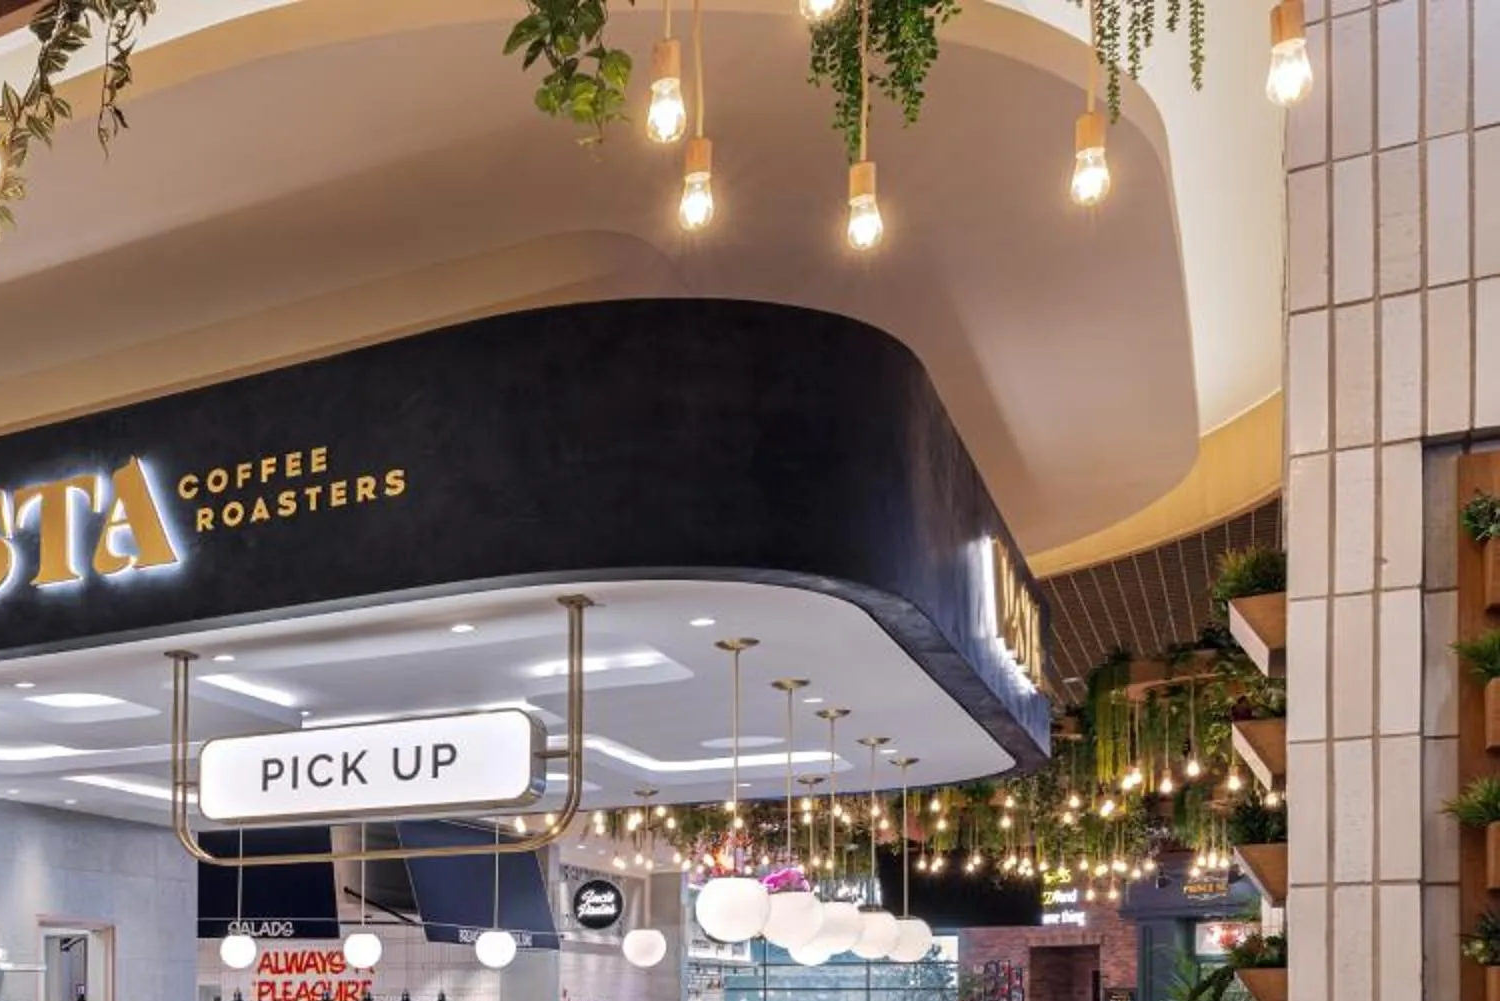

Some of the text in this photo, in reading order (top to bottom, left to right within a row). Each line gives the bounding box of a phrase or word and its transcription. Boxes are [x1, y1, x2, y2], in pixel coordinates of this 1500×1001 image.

[177, 446, 328, 500] COFFEE
[196, 469, 406, 532] ROASTERS
[261, 743, 458, 792] PICK UP
[256, 950, 347, 975] ALWAYS
